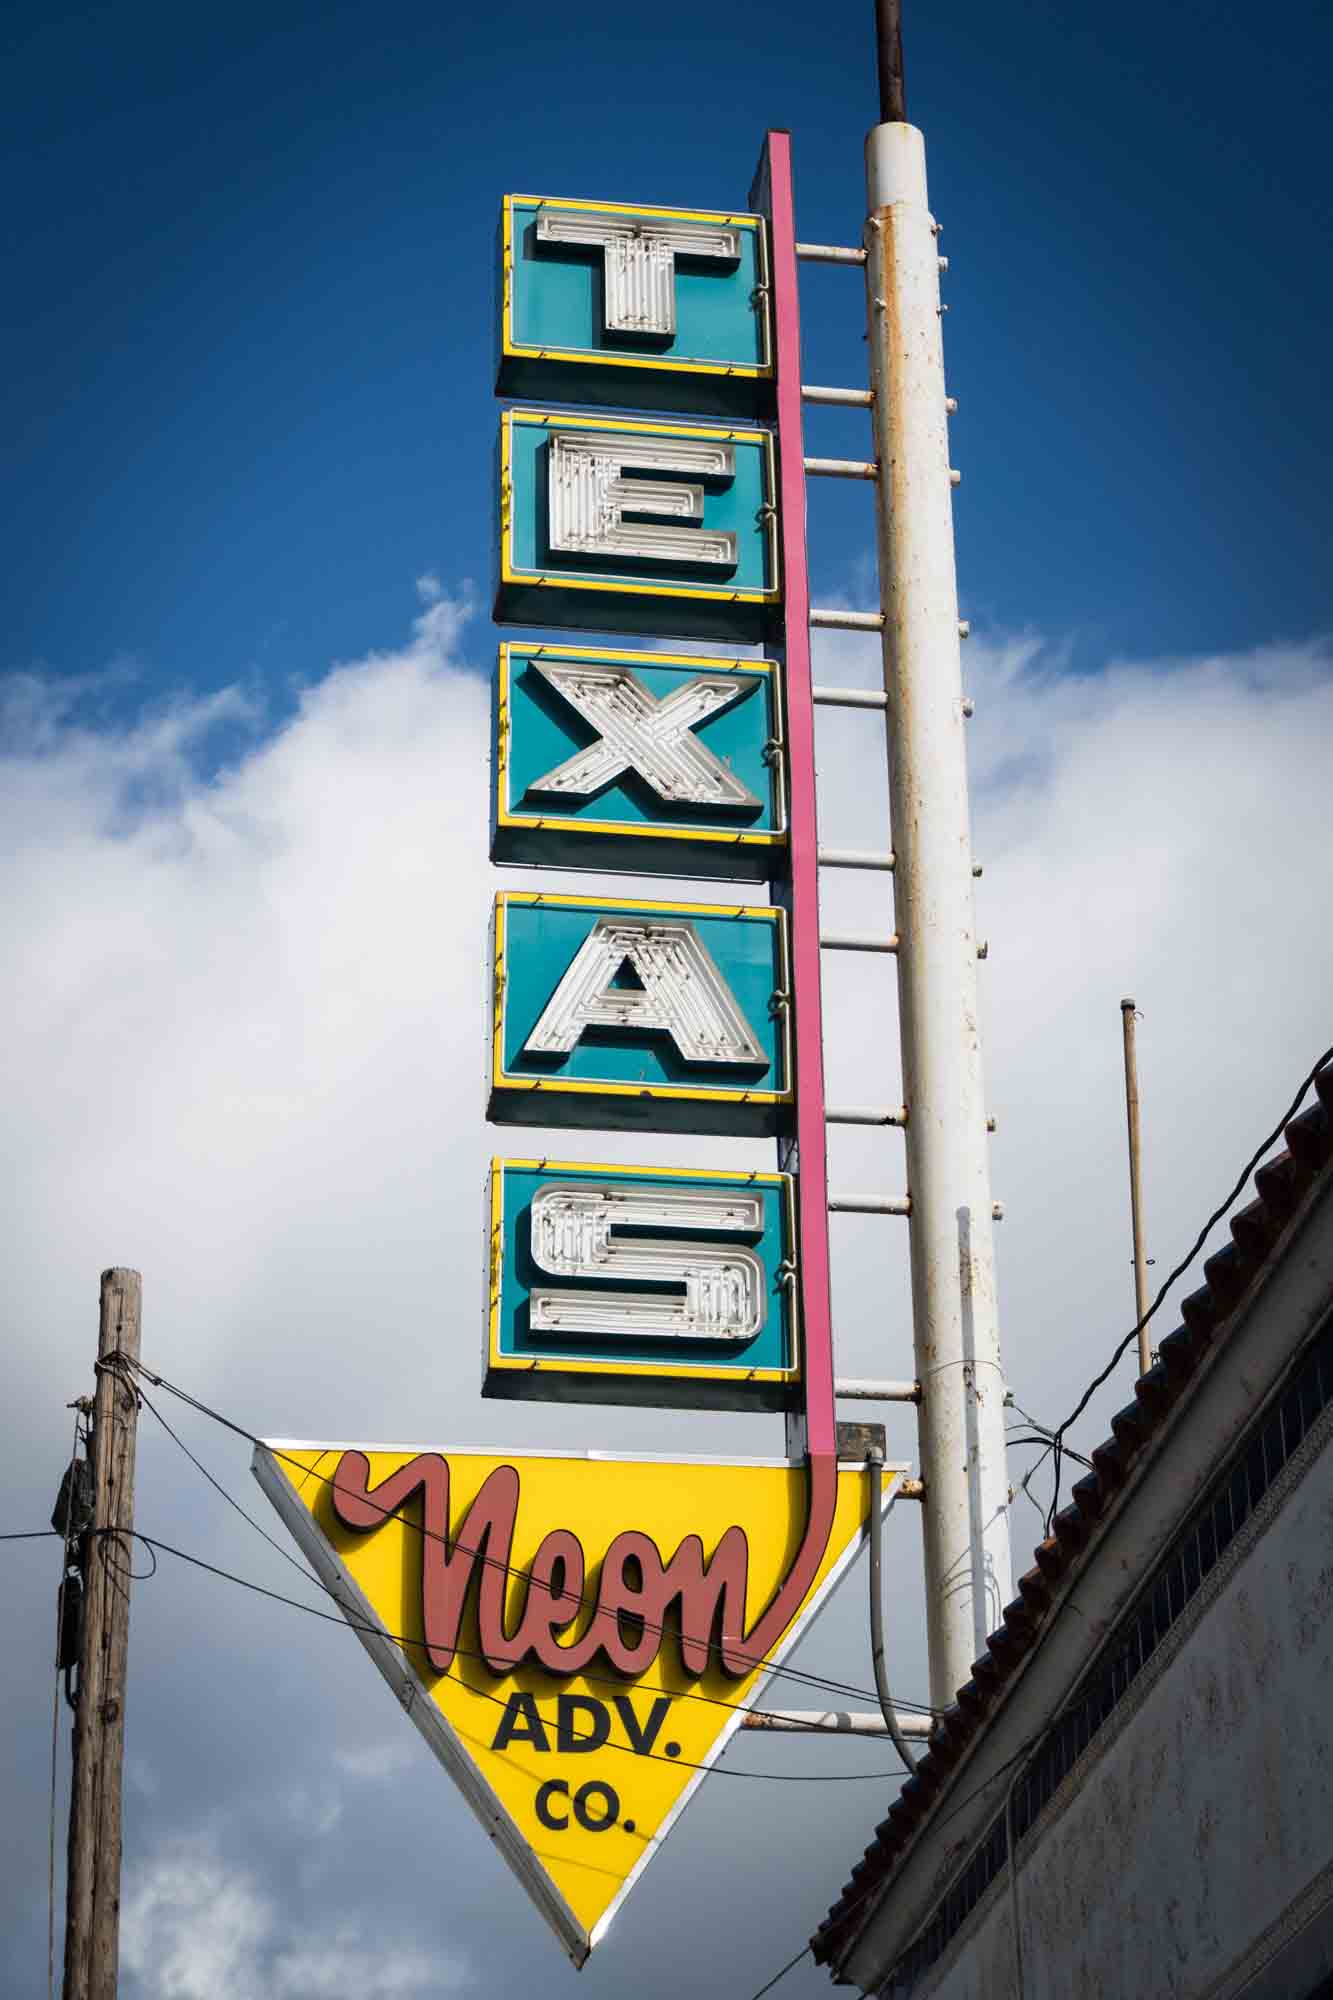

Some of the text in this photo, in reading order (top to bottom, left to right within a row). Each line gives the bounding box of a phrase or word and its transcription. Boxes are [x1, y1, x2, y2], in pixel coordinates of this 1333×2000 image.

[523, 205, 770, 1342] TEXAS
[332, 1449, 838, 1678] Neon
[491, 1692, 681, 1758] ADV.
[535, 1779, 635, 1832] CO.
